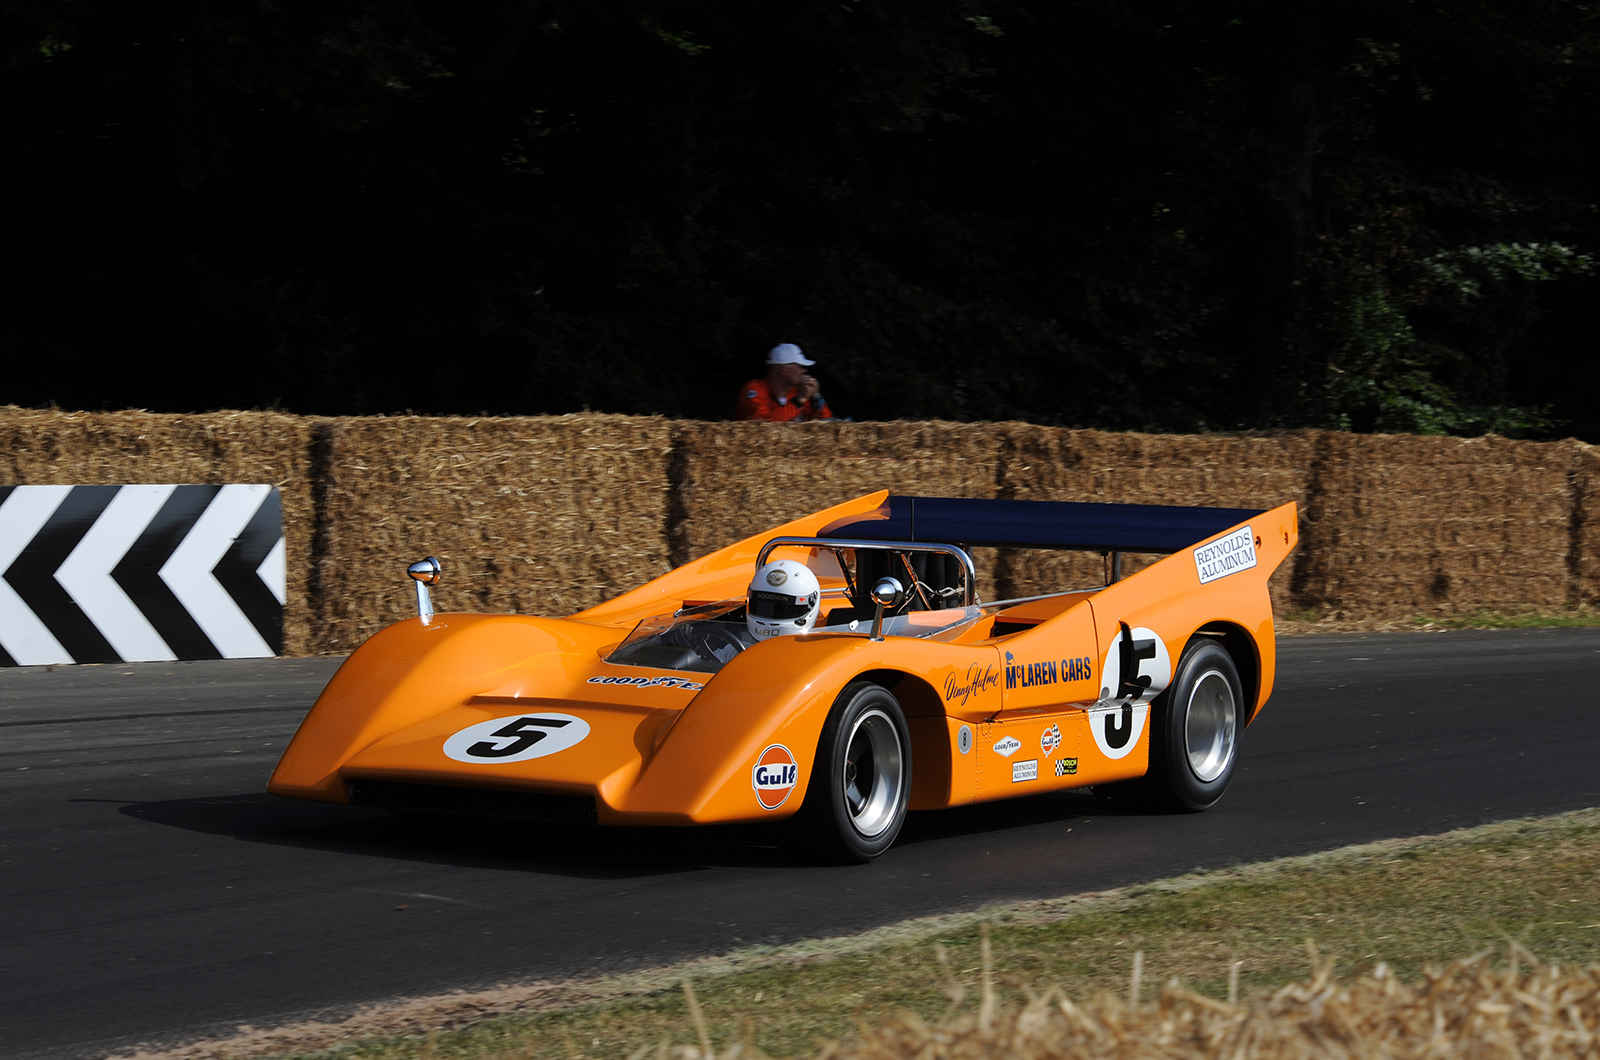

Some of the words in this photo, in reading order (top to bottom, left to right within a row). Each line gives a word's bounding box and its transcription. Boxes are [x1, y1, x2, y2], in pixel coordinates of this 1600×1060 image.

[1196, 532, 1251, 565] REYNOLDS
[1201, 547, 1255, 580] ALUMINUM
[586, 676, 706, 691] GOODYE
[1061, 656, 1092, 683] CARS
[1104, 638, 1157, 750] 5
[465, 716, 574, 758] 5
[756, 765, 796, 786] Gulf
